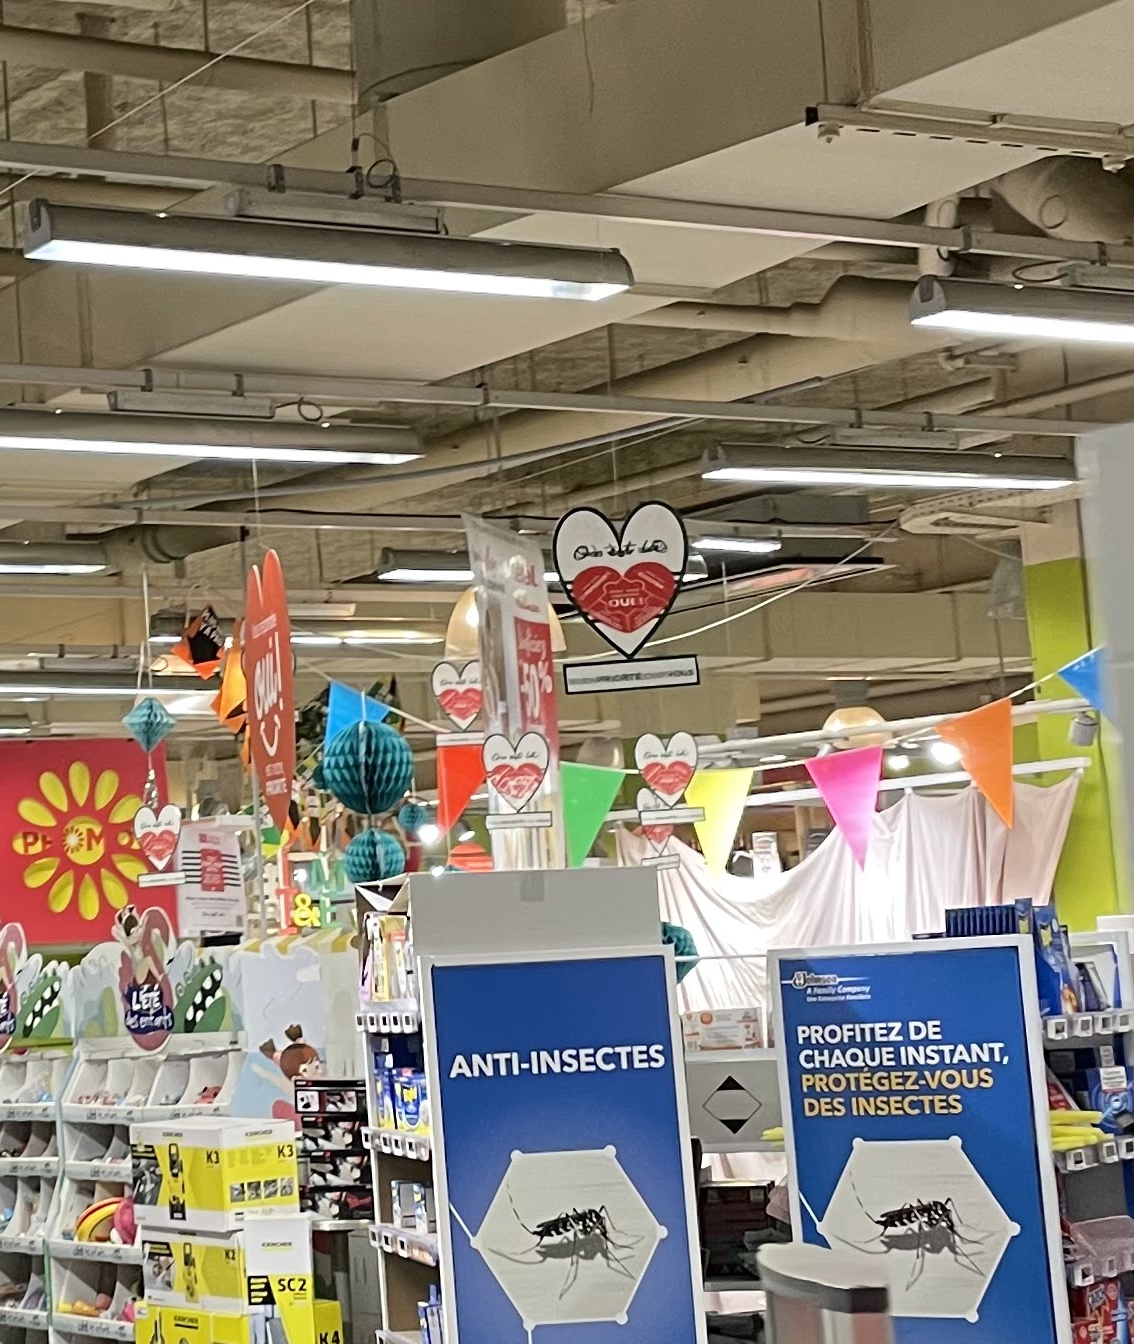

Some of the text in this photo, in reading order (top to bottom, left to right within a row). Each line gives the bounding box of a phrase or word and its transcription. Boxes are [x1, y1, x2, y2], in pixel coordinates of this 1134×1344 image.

[837, 985, 871, 995] Company
[797, 1020, 943, 1045] PROFITEZ DE
[449, 1044, 666, 1079] ANTI-INSECTES
[798, 1043, 1010, 1069] CHAQUE INSTANT,
[801, 1067, 994, 1093] PROTÉGEZ-VOUS
[803, 1094, 963, 1117] DES INSECTES
[206, 1150, 220, 1165] K3
[277, 1144, 294, 1159] K3
[224, 1249, 236, 1260] K2
